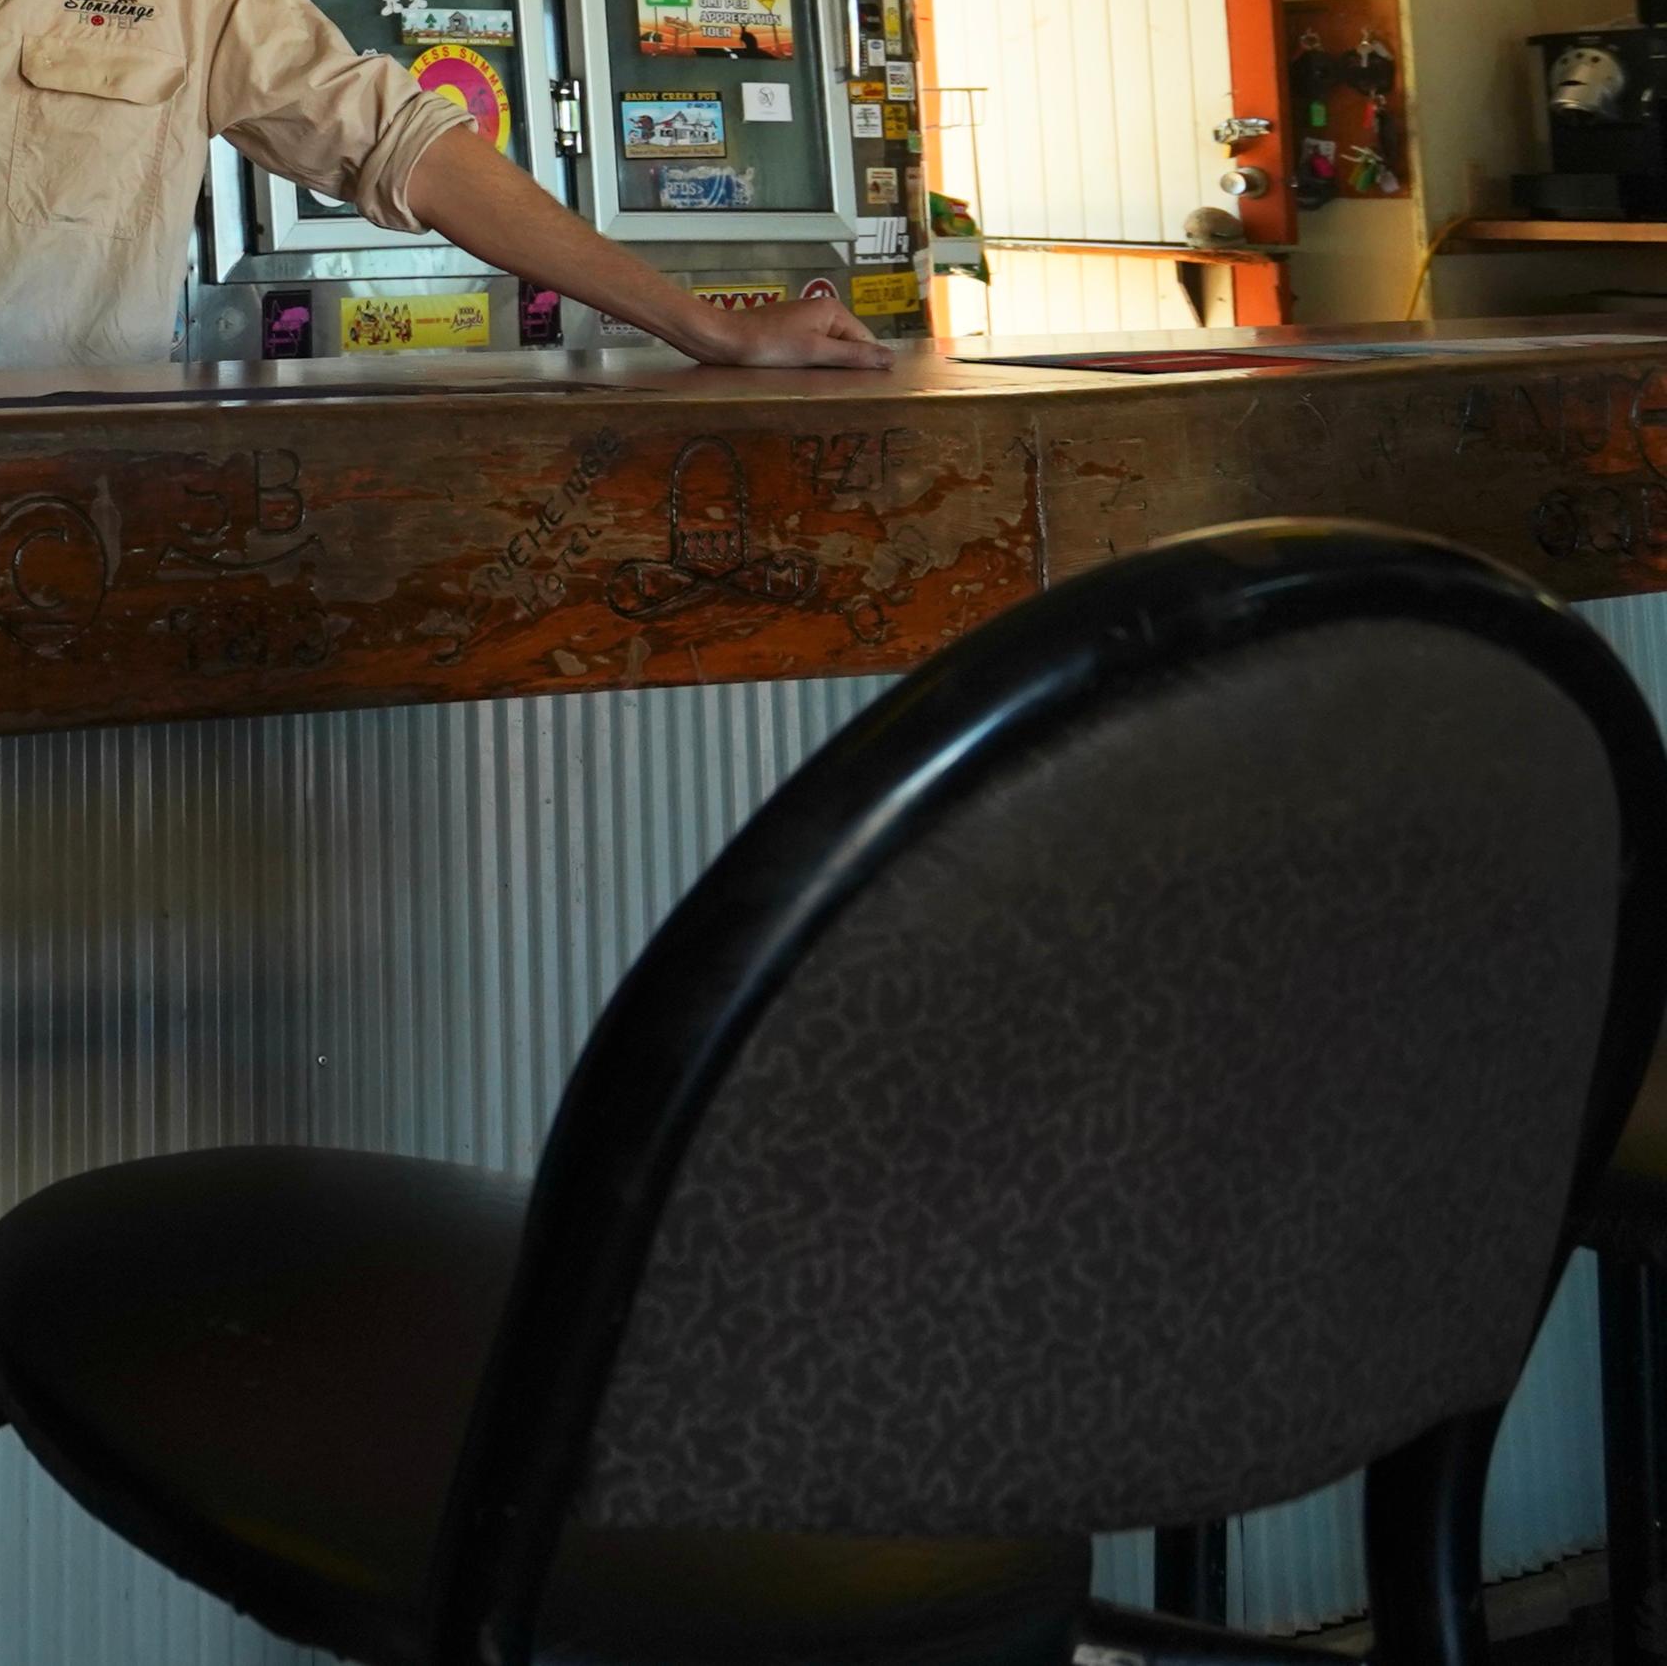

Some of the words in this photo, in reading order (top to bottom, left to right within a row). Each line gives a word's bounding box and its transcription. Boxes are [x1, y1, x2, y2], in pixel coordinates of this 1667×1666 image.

[699, 10, 782, 27] APPRECIATION
[701, 25, 732, 38] TOUR
[459, 47, 509, 113] SUMMER
[624, 92, 659, 101] SANDY
[662, 92, 696, 101] CREEK
[697, 92, 718, 101] PUB
[450, 308, 485, 333] Angels
